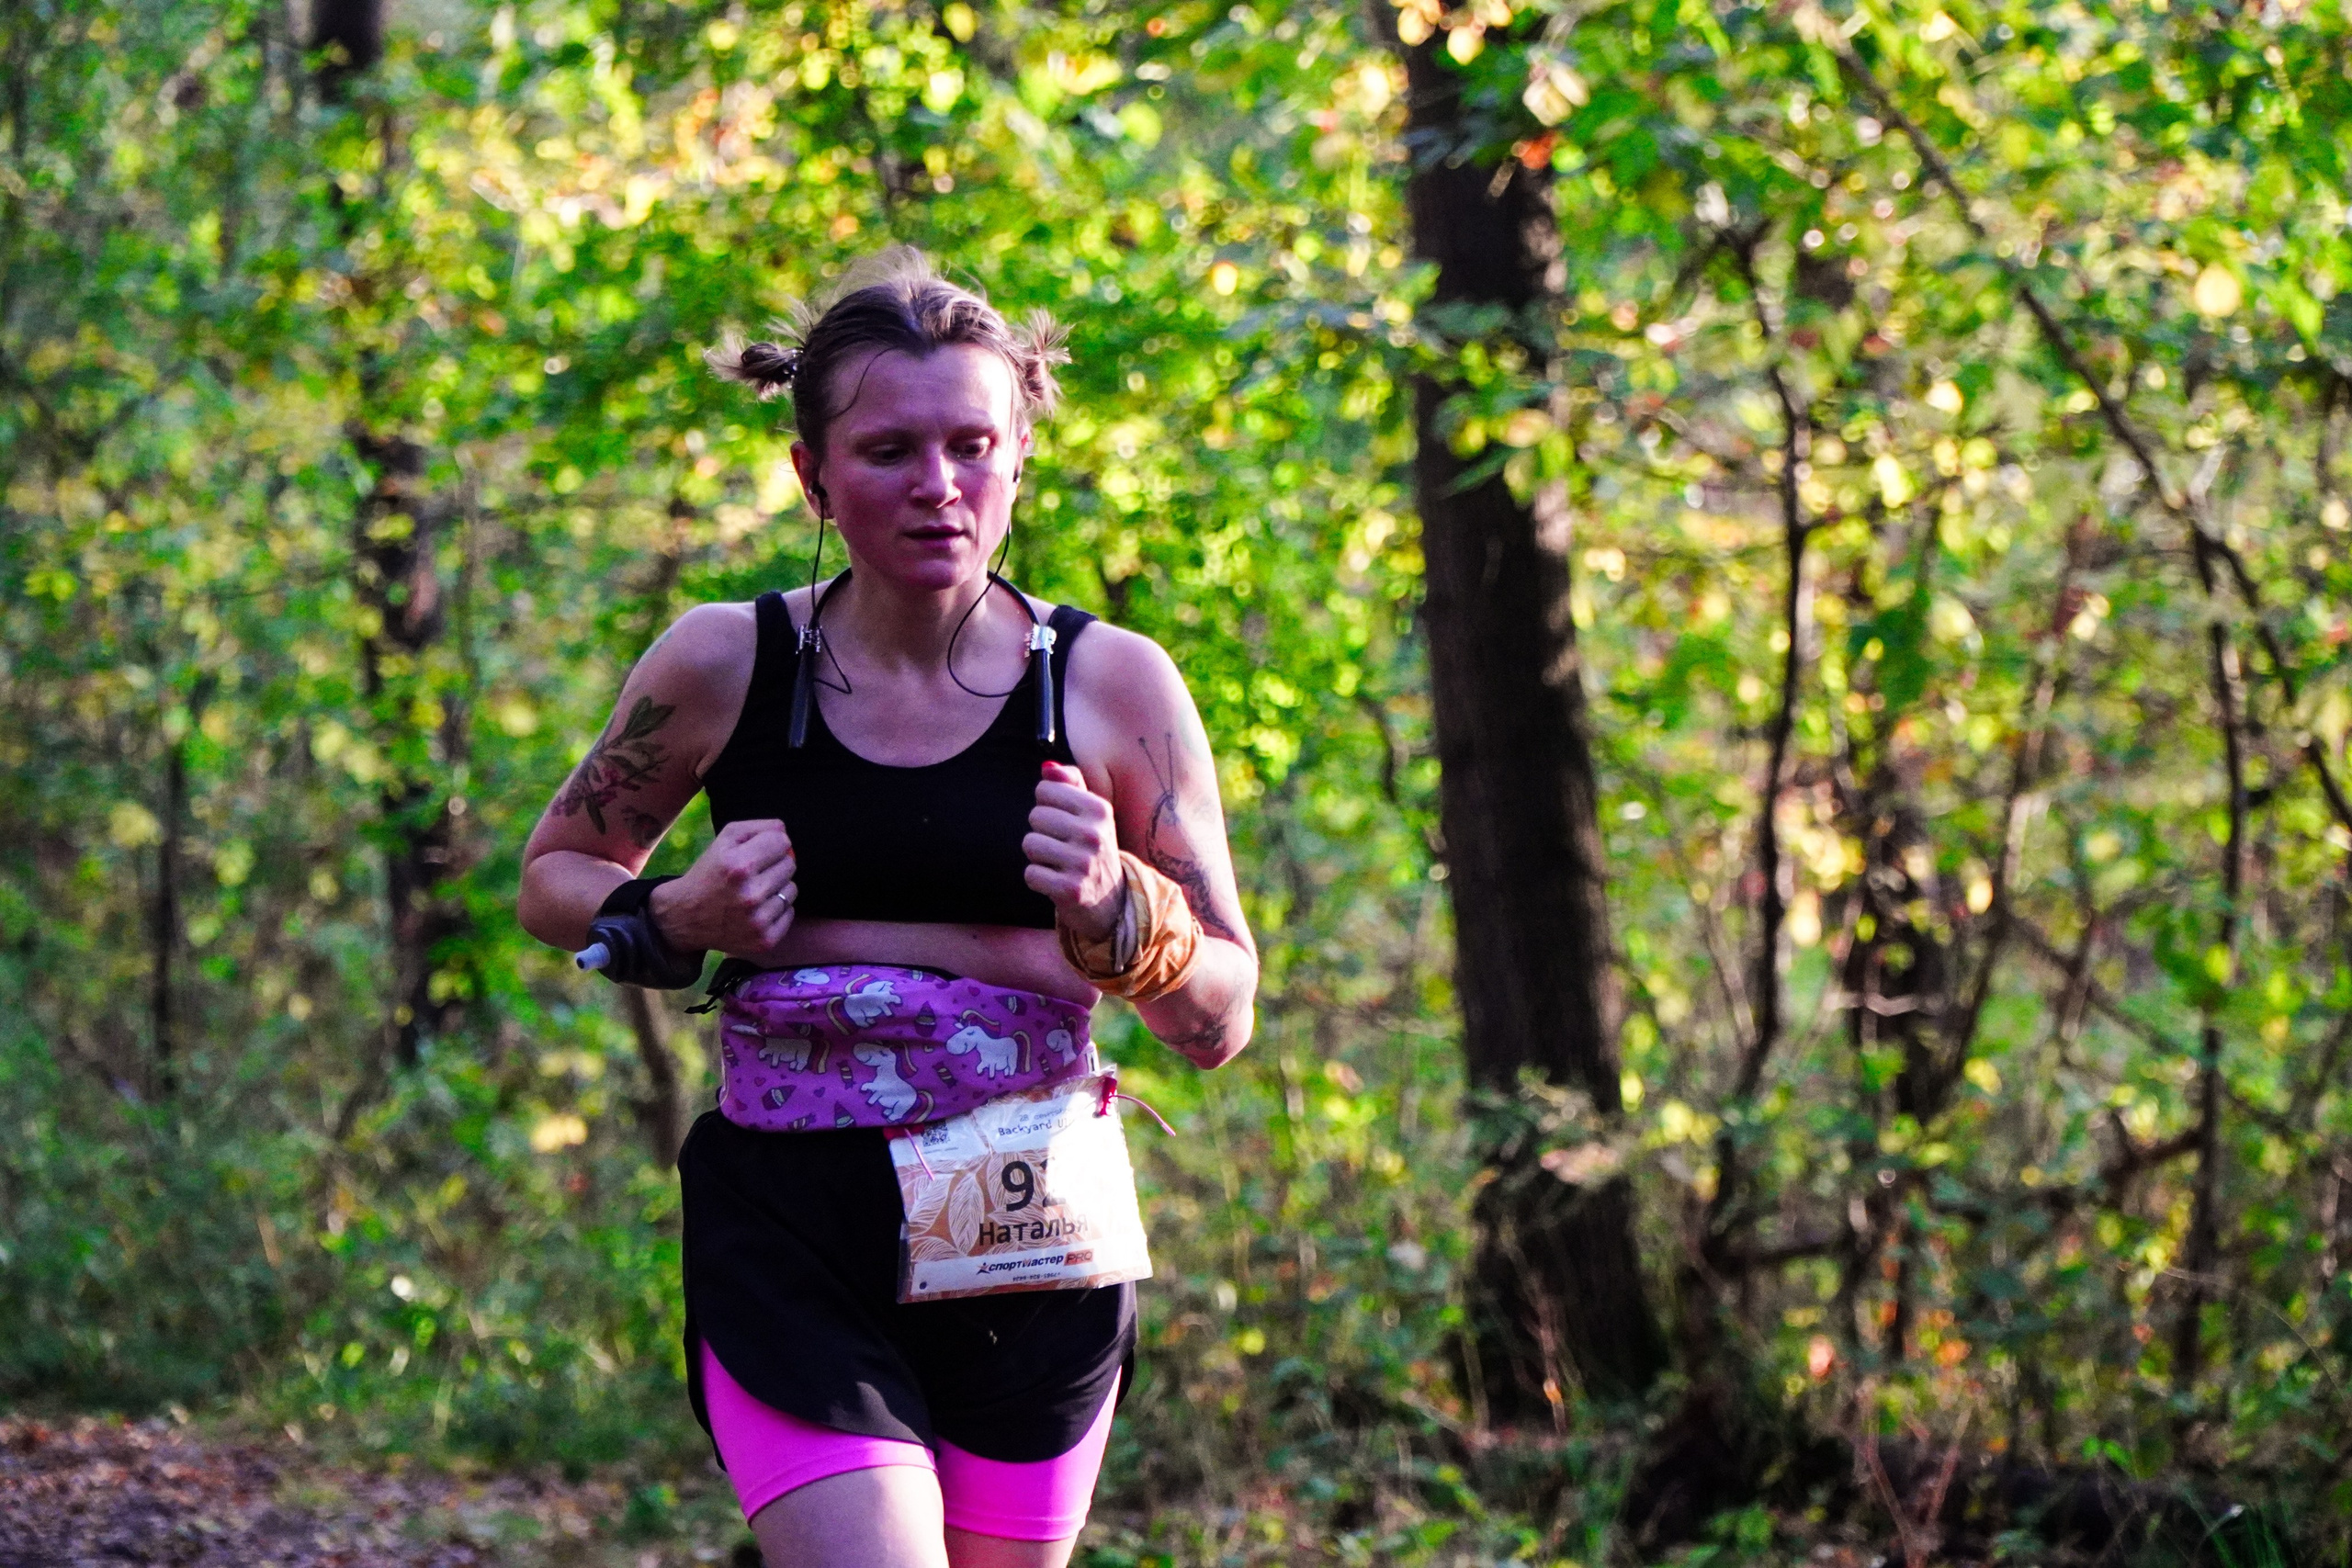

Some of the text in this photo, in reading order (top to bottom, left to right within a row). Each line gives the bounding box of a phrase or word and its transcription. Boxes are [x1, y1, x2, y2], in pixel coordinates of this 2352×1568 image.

[998, 1120, 1052, 1136] Backyard
[978, 1213, 1089, 1247] Наталья
[1067, 1250, 1093, 1264] PRO
